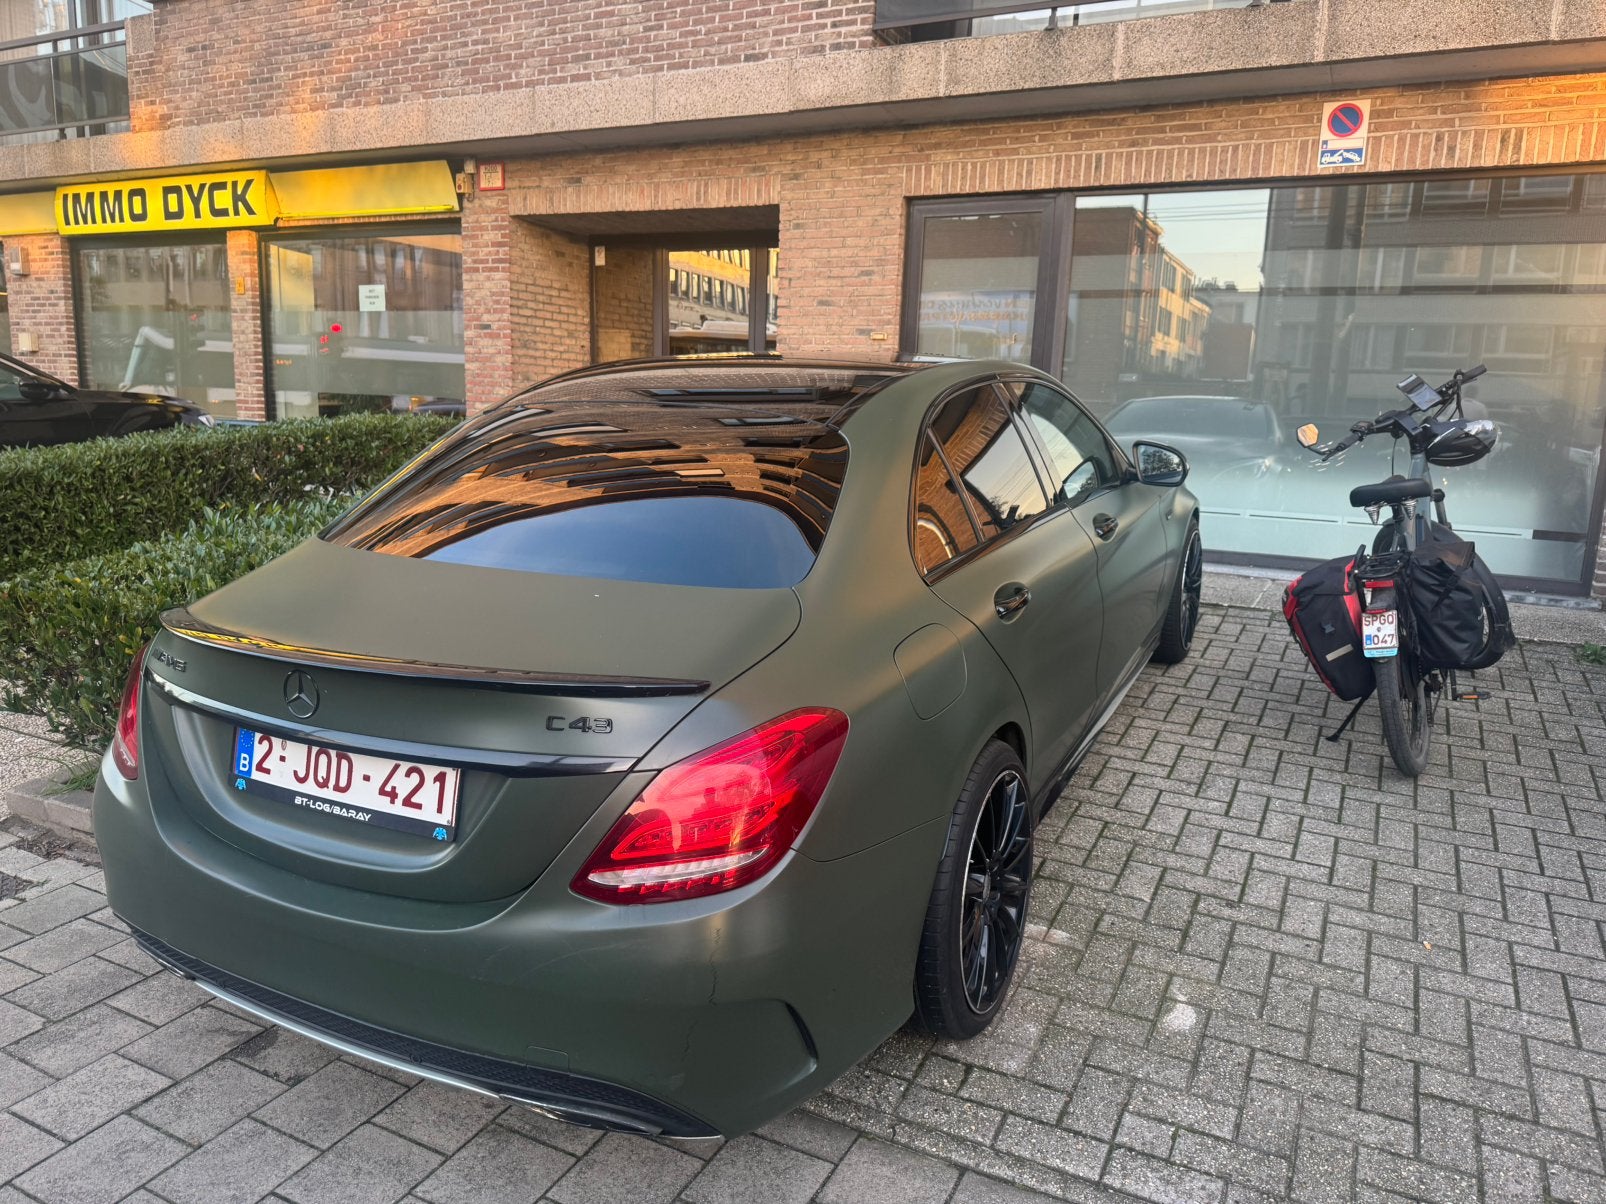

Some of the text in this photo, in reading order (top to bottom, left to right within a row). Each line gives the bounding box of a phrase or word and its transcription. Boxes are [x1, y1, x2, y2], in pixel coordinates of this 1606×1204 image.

[62, 178, 257, 226] IMMO DYCK
[1373, 634, 1394, 645] 047
[239, 753, 250, 772] B
[294, 795, 372, 822] BT-LOG/BARAY
